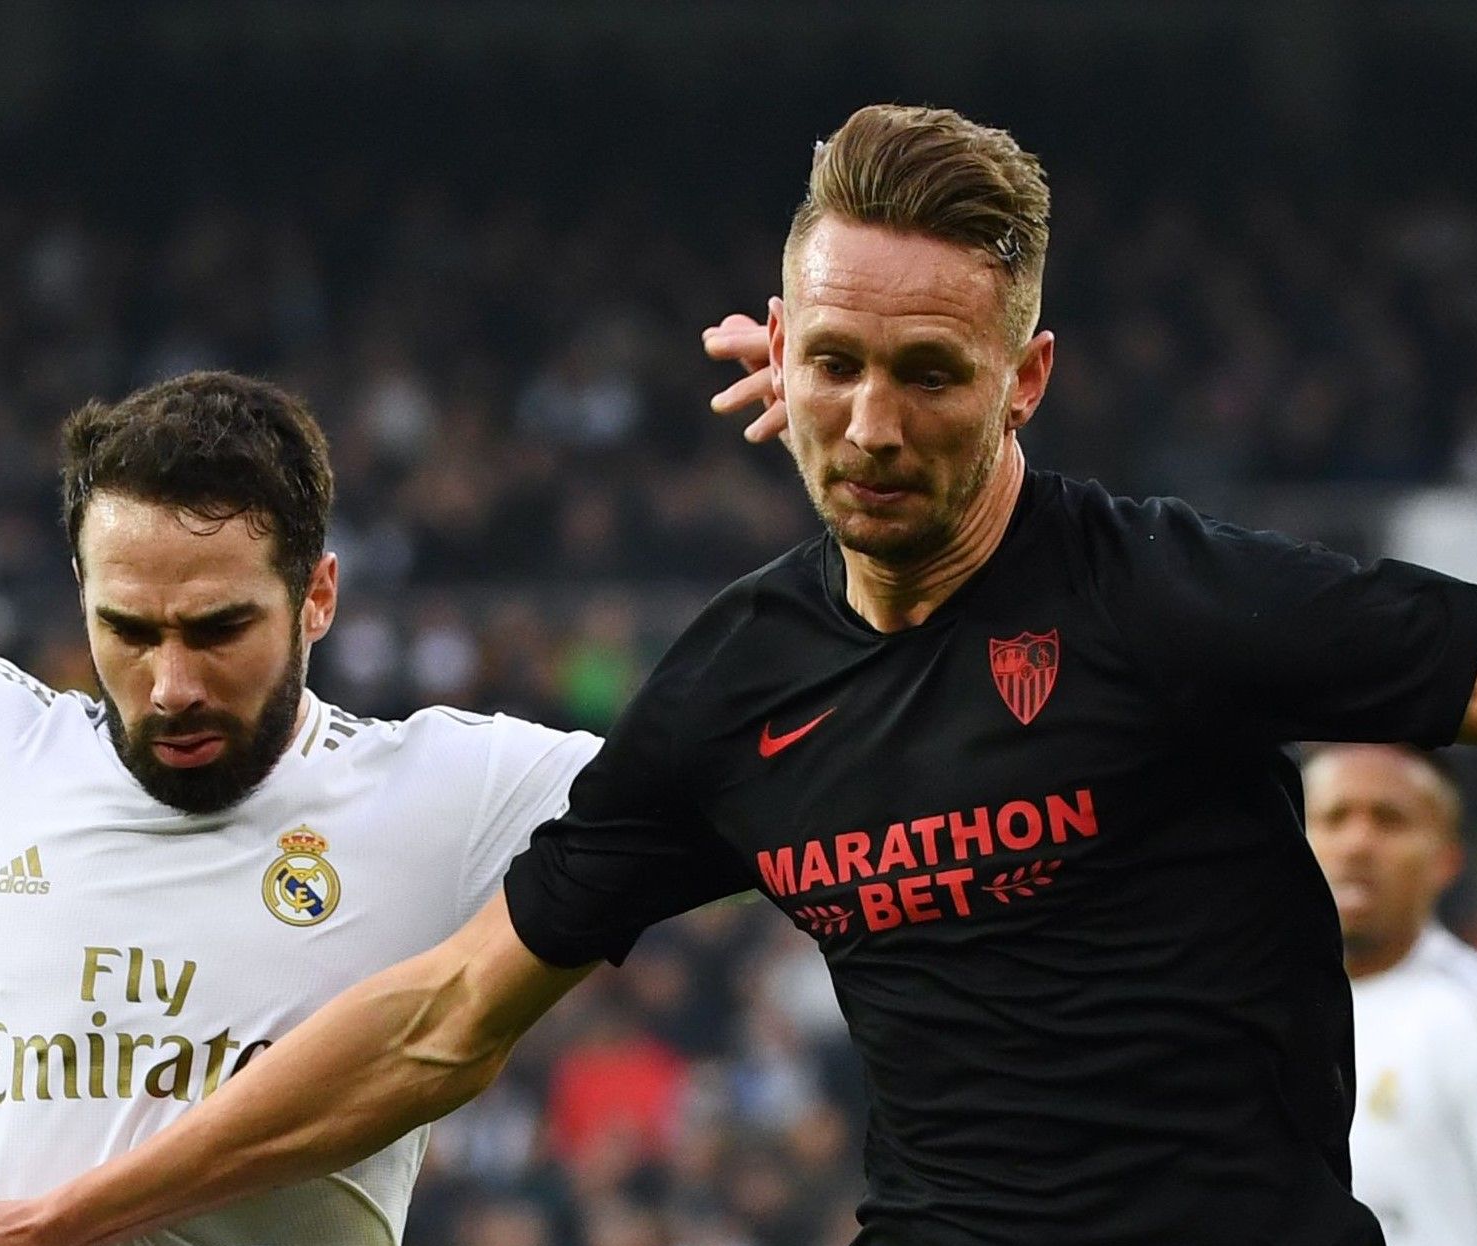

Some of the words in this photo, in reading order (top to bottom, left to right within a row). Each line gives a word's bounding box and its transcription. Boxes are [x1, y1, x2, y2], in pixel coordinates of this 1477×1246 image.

[757, 789, 1100, 897] MARATHON
[857, 868, 974, 932] BET
[80, 946, 197, 1017] Fly
